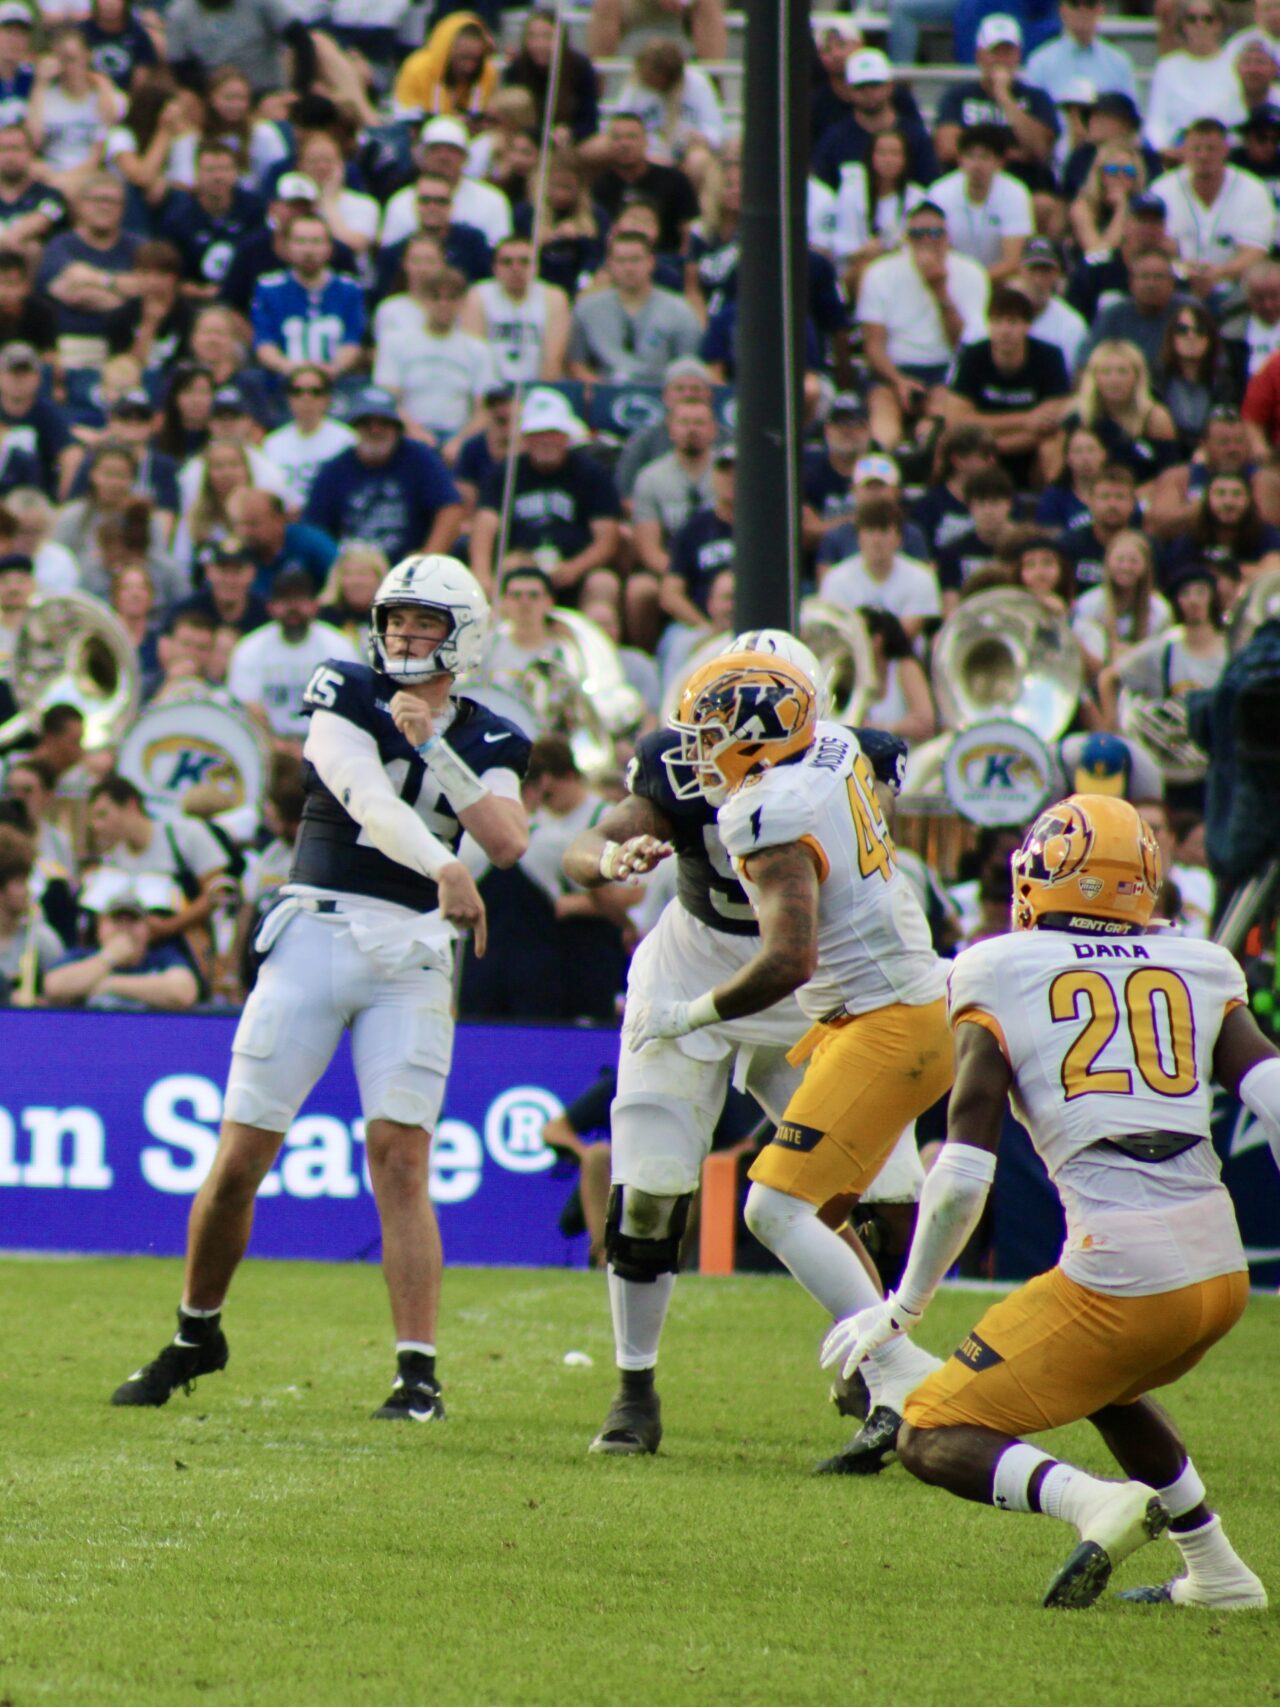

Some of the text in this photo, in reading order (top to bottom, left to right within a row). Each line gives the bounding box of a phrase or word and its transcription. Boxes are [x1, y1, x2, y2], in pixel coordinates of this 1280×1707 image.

[282, 316, 344, 365] 10
[303, 666, 345, 708] 15
[730, 685, 796, 740] K
[163, 751, 221, 790] K
[979, 755, 1017, 788] K
[845, 752, 898, 883] 45
[1069, 917, 1105, 931] KENT
[1049, 966, 1199, 1101] 20
[140, 1073, 566, 1203] Sae®
